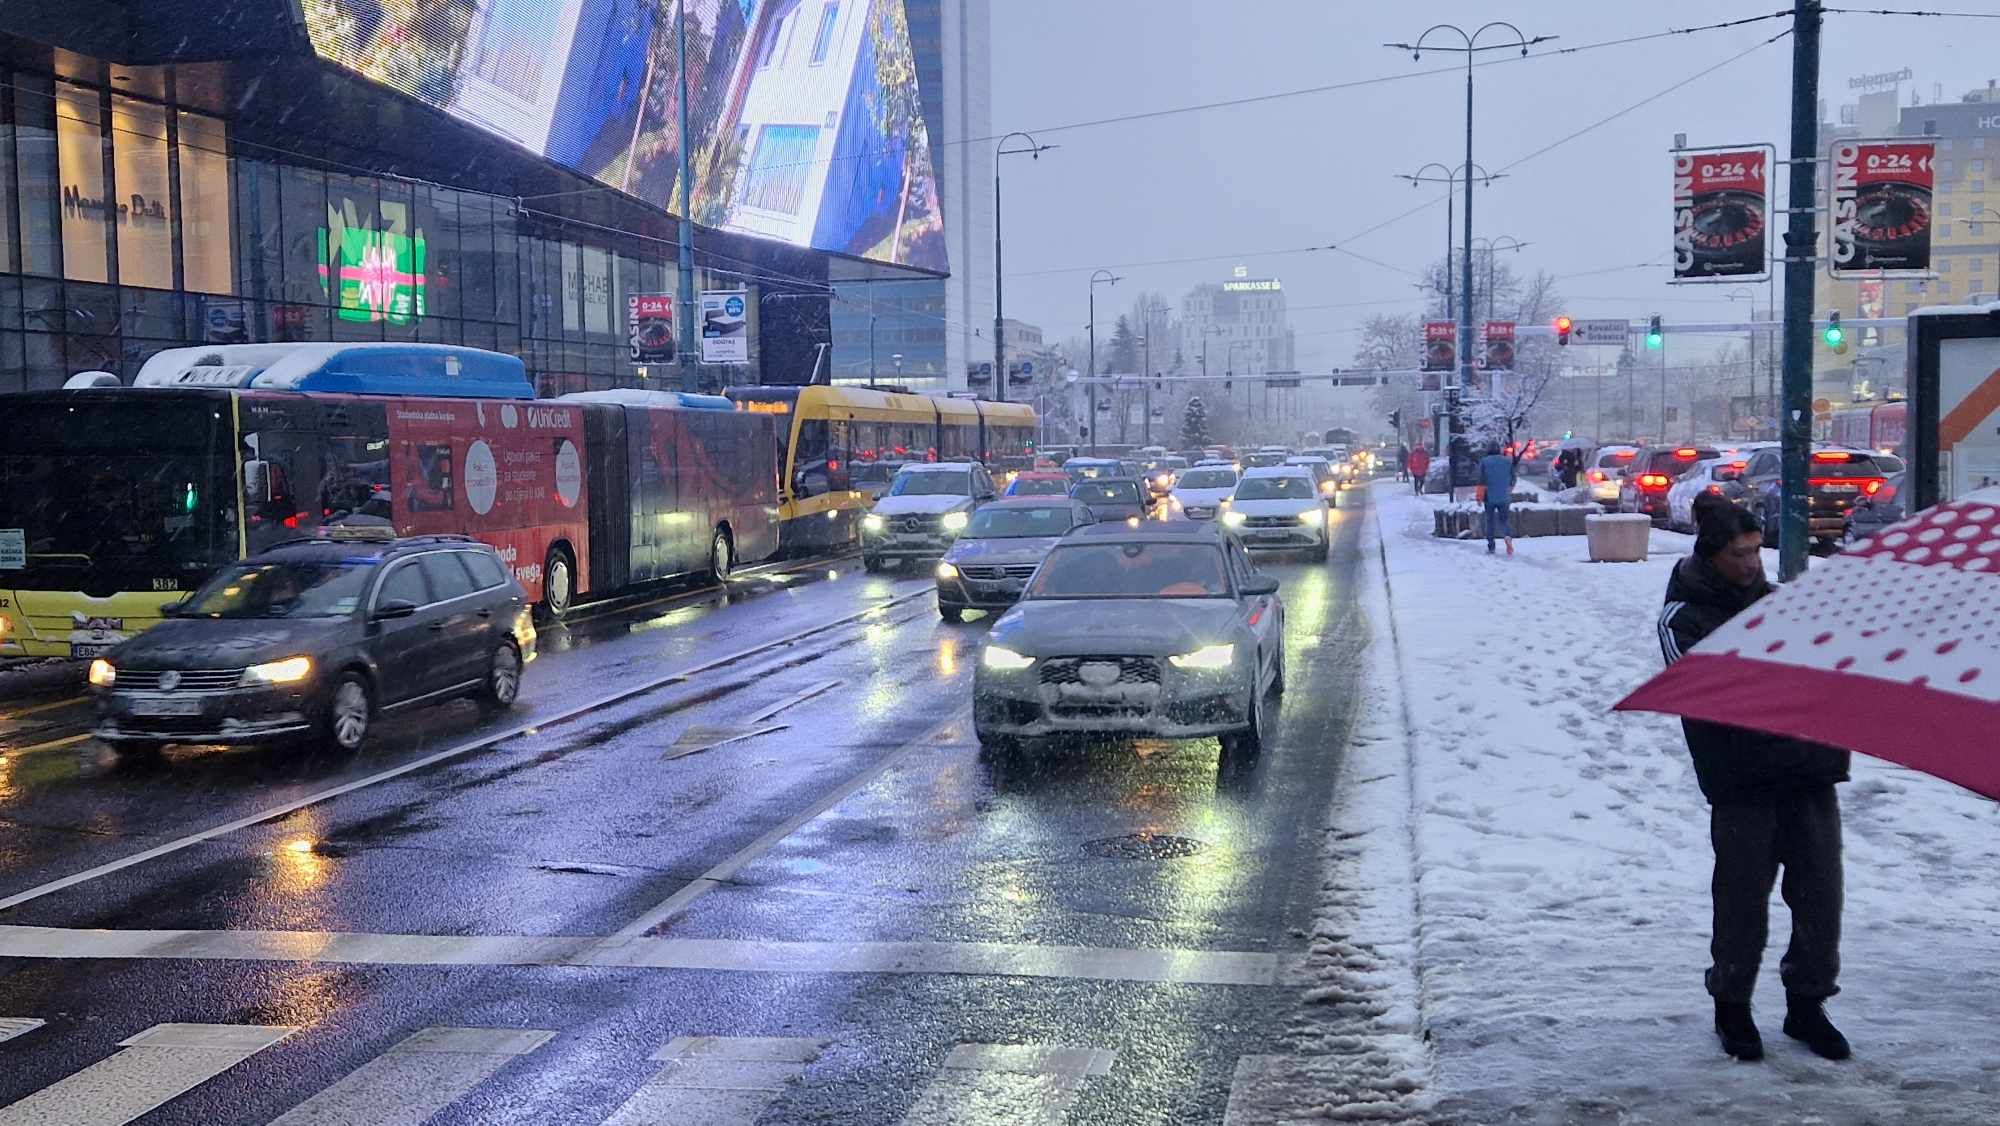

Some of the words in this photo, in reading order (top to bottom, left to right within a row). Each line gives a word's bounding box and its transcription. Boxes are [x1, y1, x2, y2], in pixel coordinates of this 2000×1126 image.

[1702, 163, 1745, 178] 0-24
[1866, 154, 1912, 169] 0-24
[1674, 156, 1694, 271] CASINO
[1835, 143, 1858, 264] CASINO
[629, 296, 640, 359] CASINO
[538, 407, 572, 428] UniCredit
